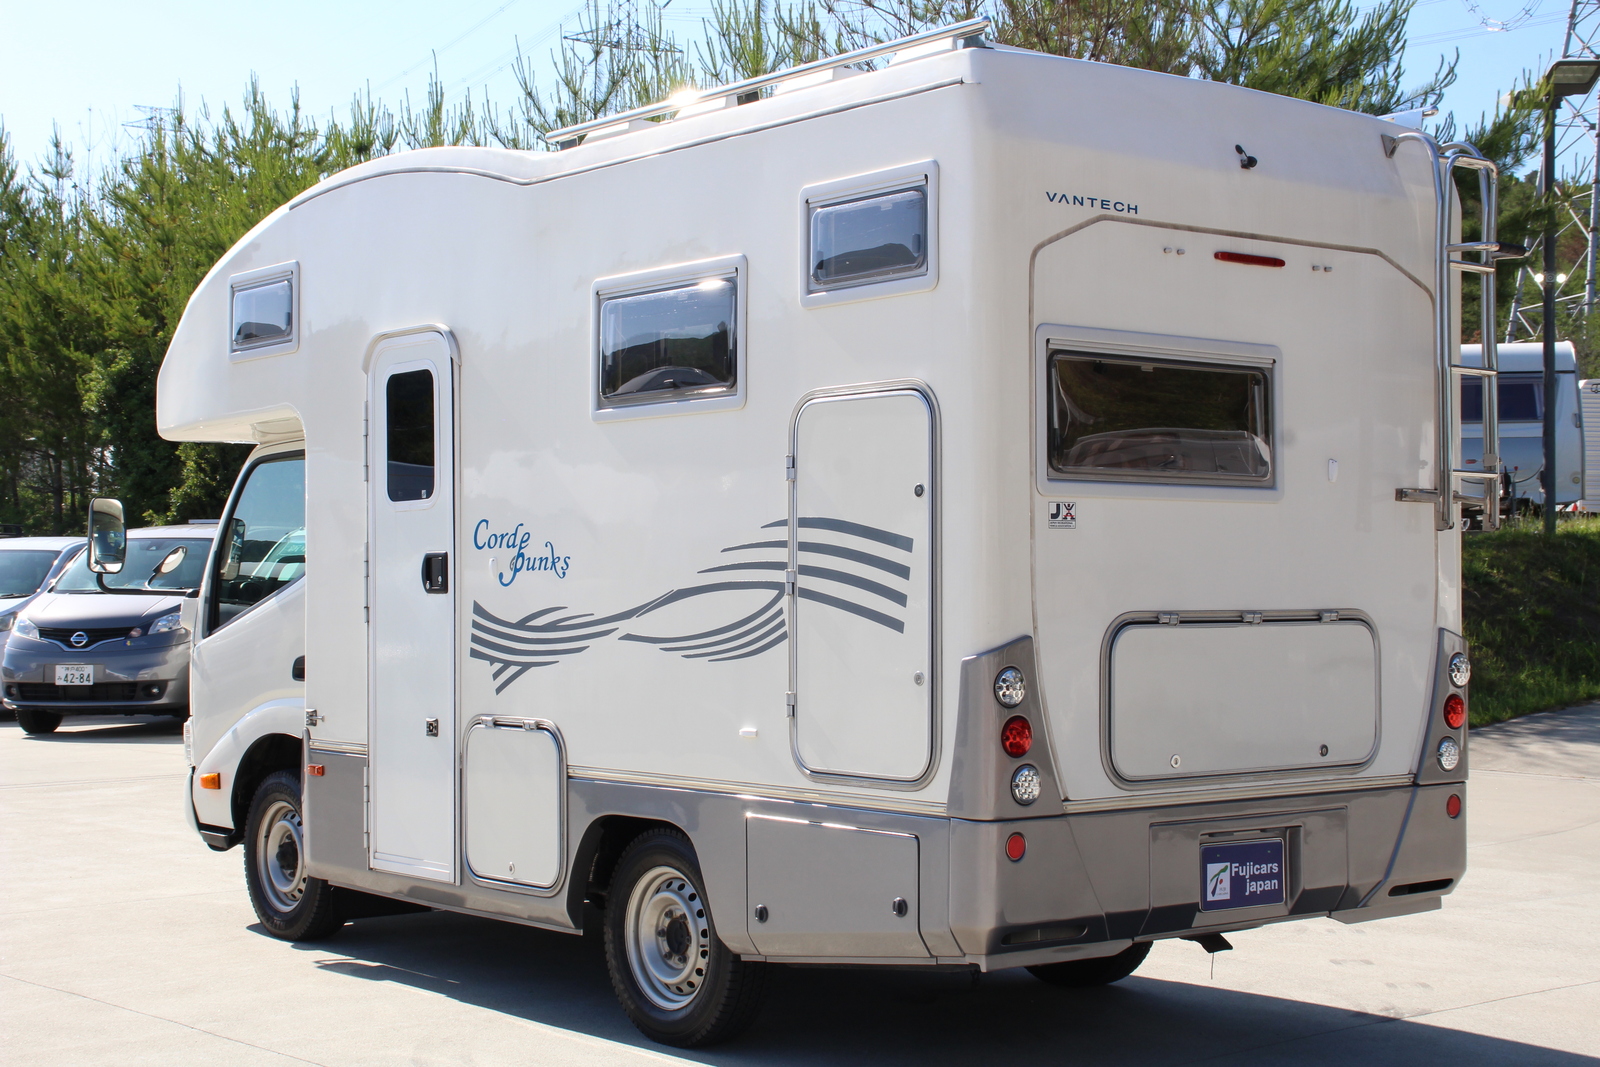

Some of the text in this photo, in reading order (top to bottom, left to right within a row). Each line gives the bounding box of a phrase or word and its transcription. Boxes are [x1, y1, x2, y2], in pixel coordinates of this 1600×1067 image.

[1045, 191, 1138, 215] VANTECH
[473, 518, 531, 551] Corde
[63, 673, 91, 684] 42-84
[1231, 862, 1279, 879] Fujicars
[1245, 879, 1279, 896] japan
